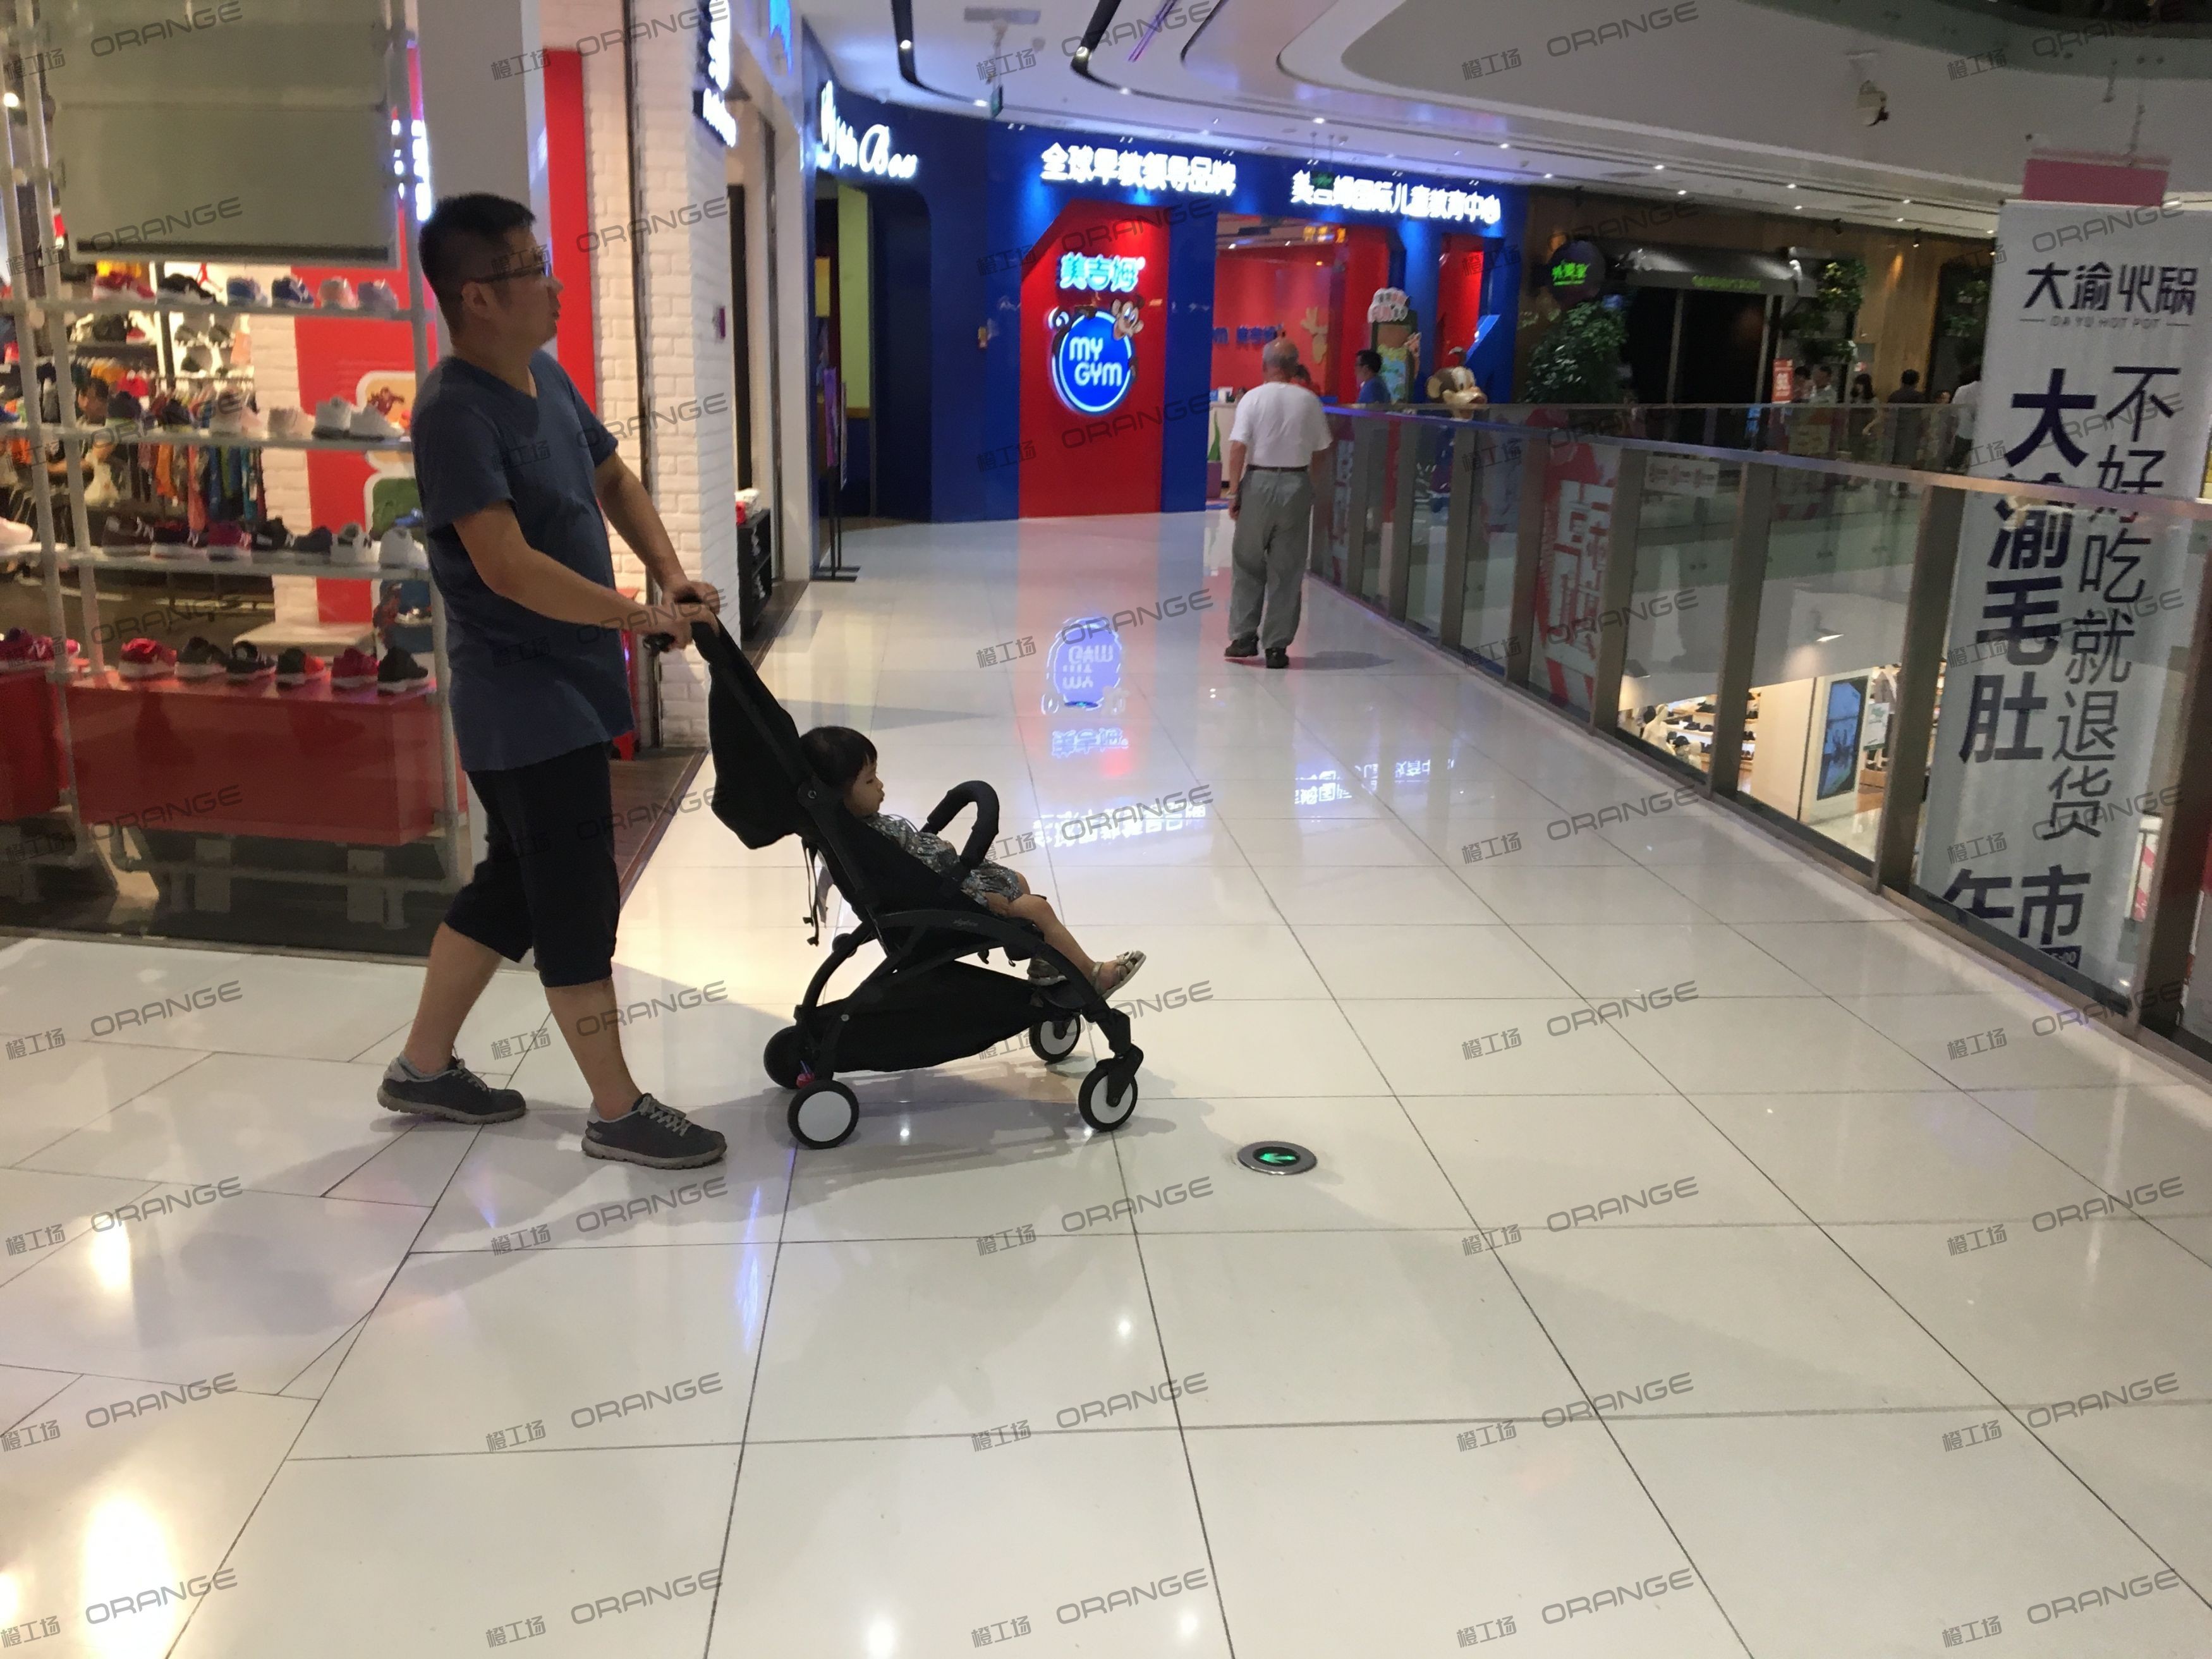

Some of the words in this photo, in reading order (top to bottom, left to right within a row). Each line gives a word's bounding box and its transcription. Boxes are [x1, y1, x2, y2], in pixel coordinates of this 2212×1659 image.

[1060, 252, 1140, 292] 美吉姆
[1074, 362, 1122, 387] GYM
